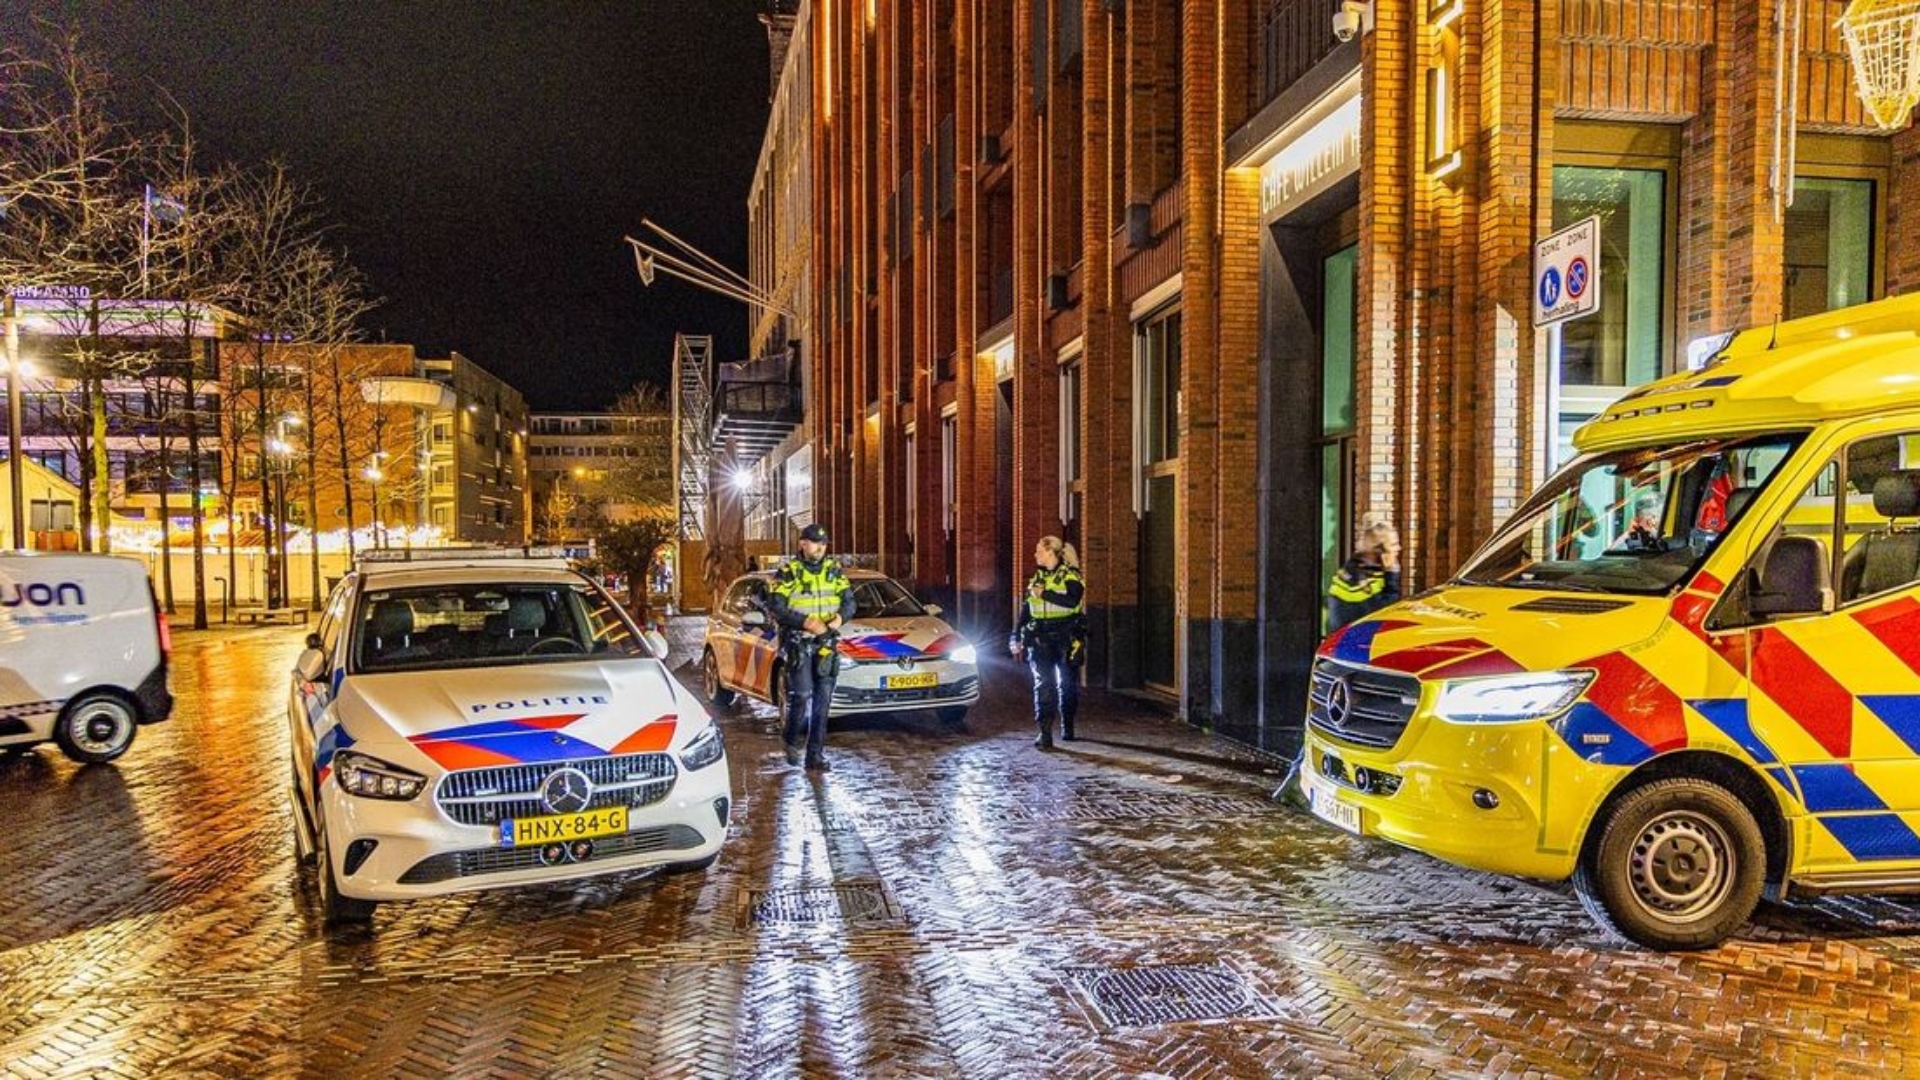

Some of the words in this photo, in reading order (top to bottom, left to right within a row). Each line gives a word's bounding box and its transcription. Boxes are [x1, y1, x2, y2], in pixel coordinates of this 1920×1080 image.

[1541, 240, 1561, 257] ZONE
[1567, 228, 1588, 247] ZONE
[471, 696, 608, 713] POLITIE
[519, 811, 621, 841] HNX-84-G
